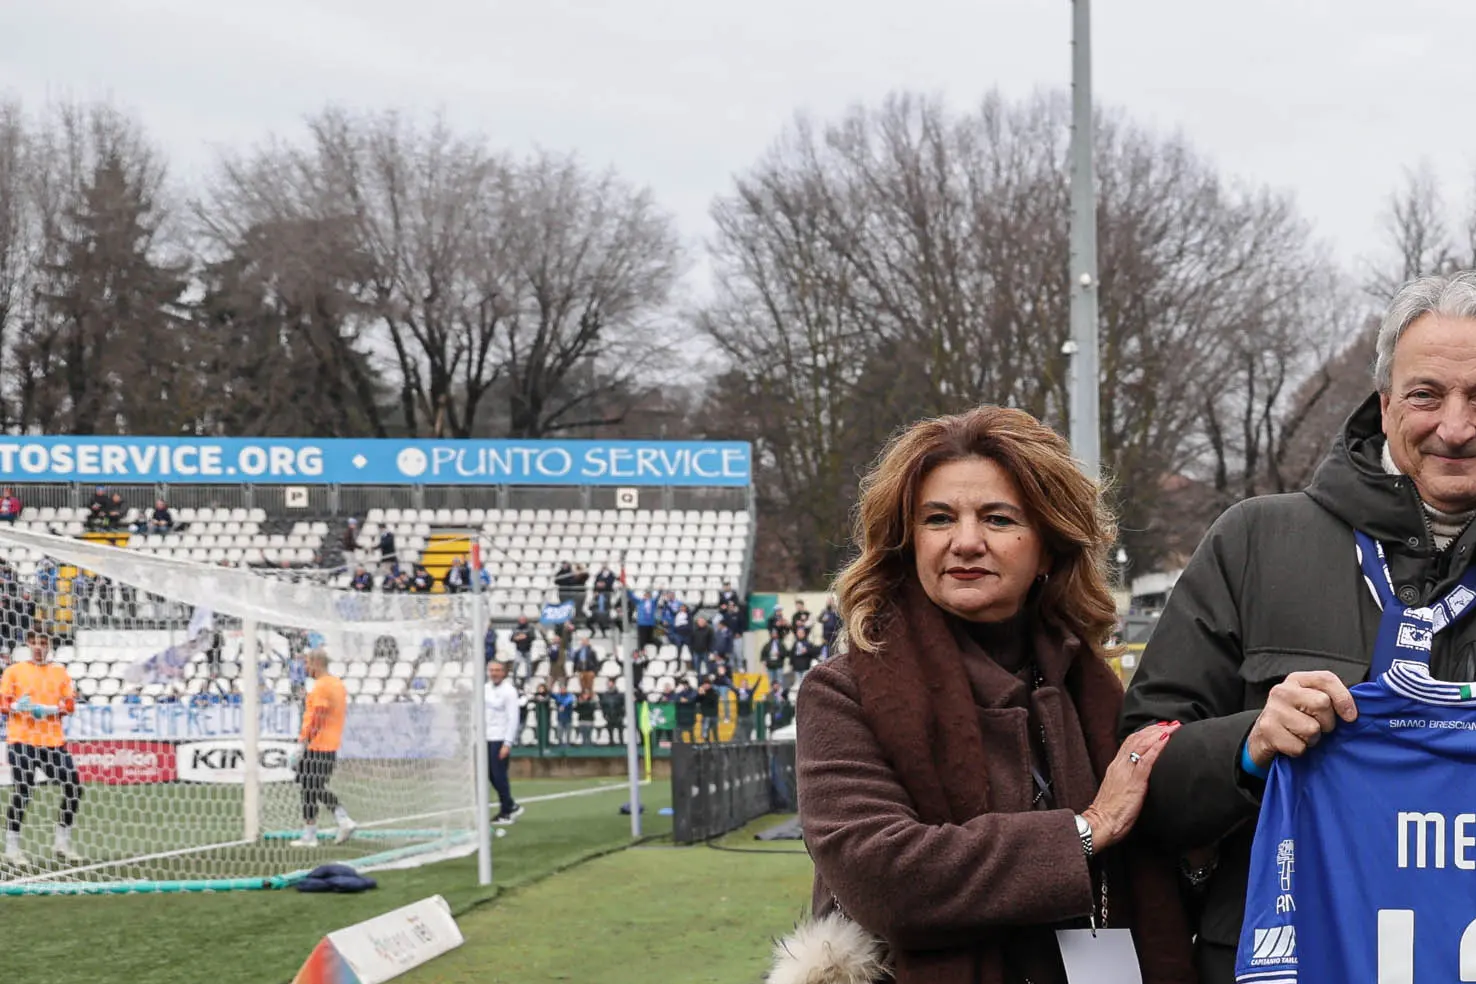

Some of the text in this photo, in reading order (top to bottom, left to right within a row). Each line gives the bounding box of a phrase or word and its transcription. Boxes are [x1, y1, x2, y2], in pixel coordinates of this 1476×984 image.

[0, 443, 323, 476] TOSERVICE.ORG
[431, 447, 748, 478] PUNTO SERVICE
[291, 491, 303, 501] P
[1389, 719, 1426, 729] SIAMO
